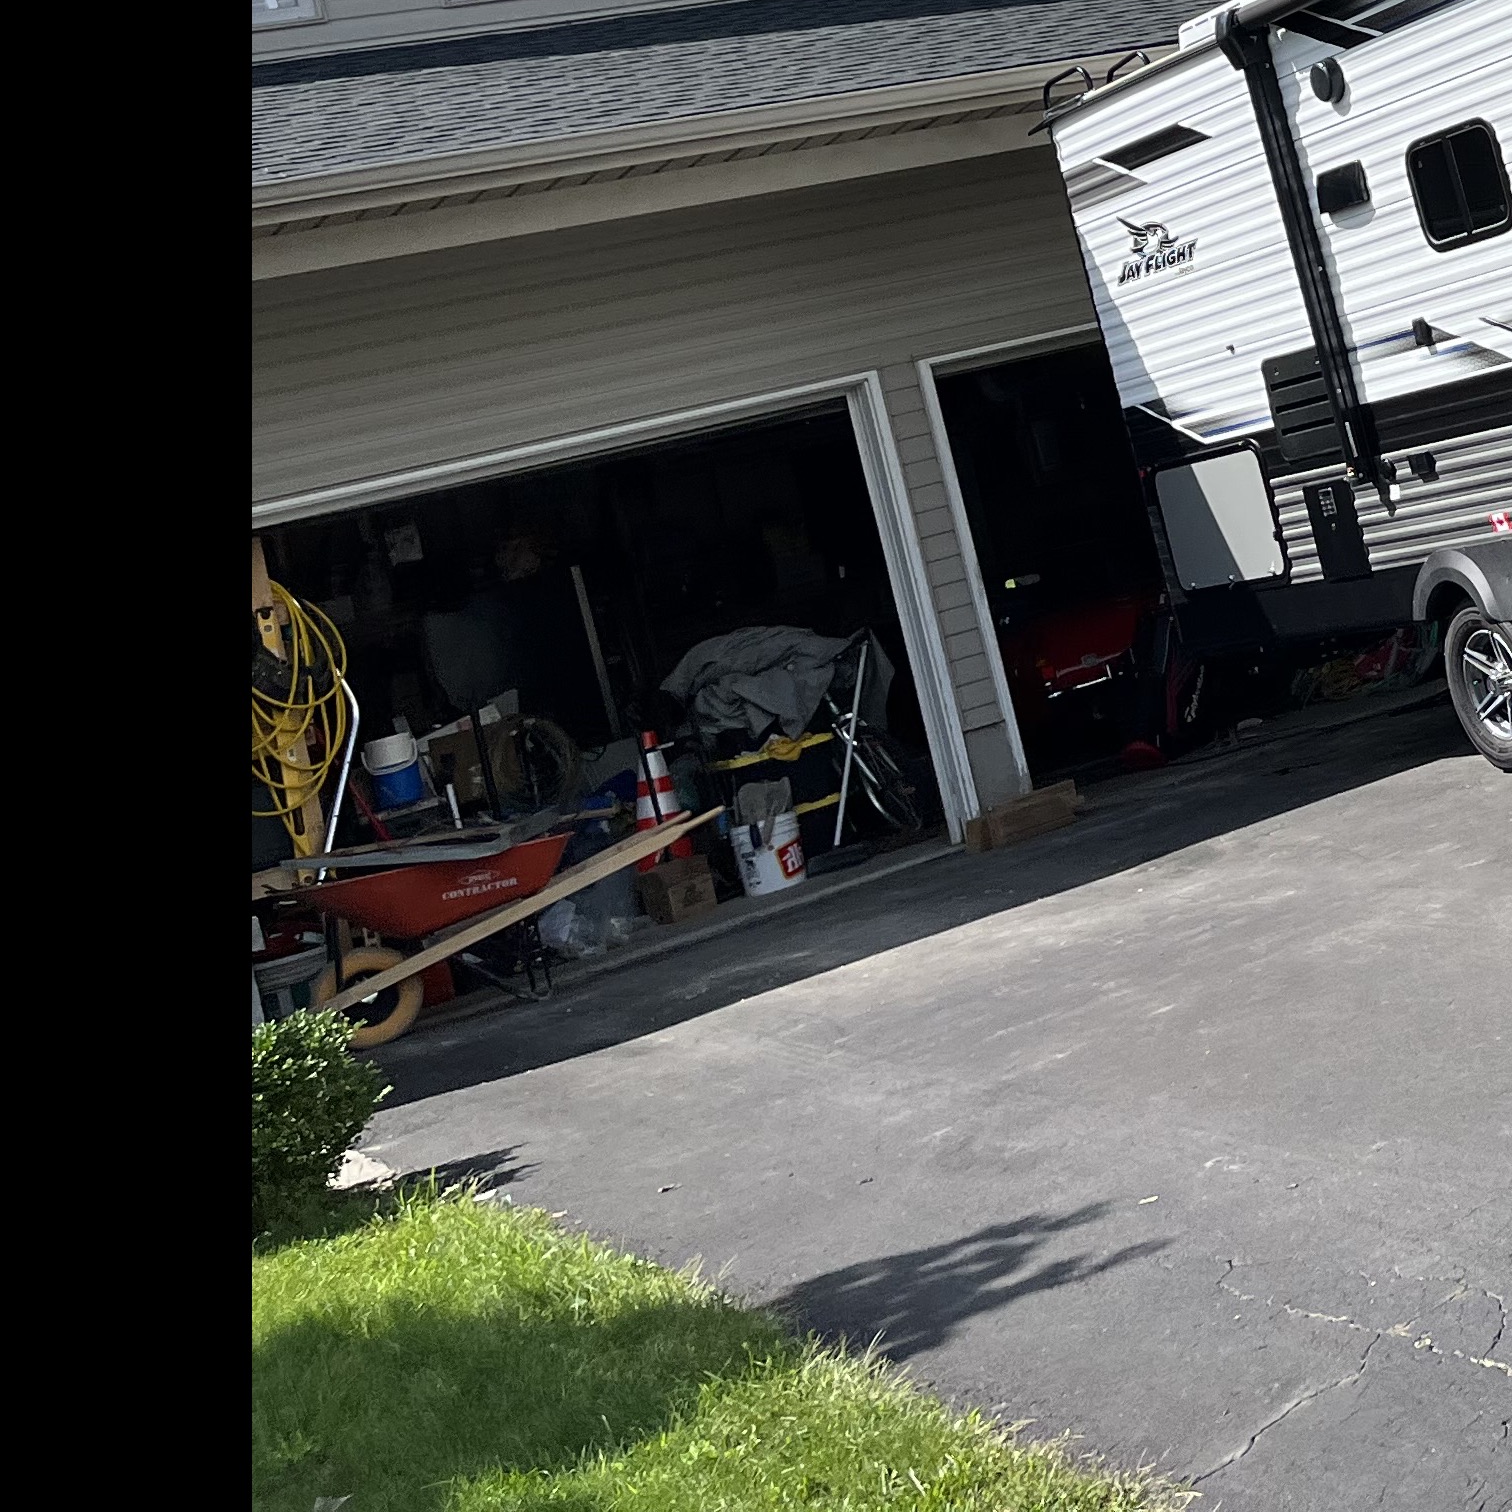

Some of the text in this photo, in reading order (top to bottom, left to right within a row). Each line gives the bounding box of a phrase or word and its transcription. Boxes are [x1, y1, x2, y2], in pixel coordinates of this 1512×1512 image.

[1118, 238, 1198, 286] JAY FLIGHT
[442, 877, 518, 900] CONTRACTOR
